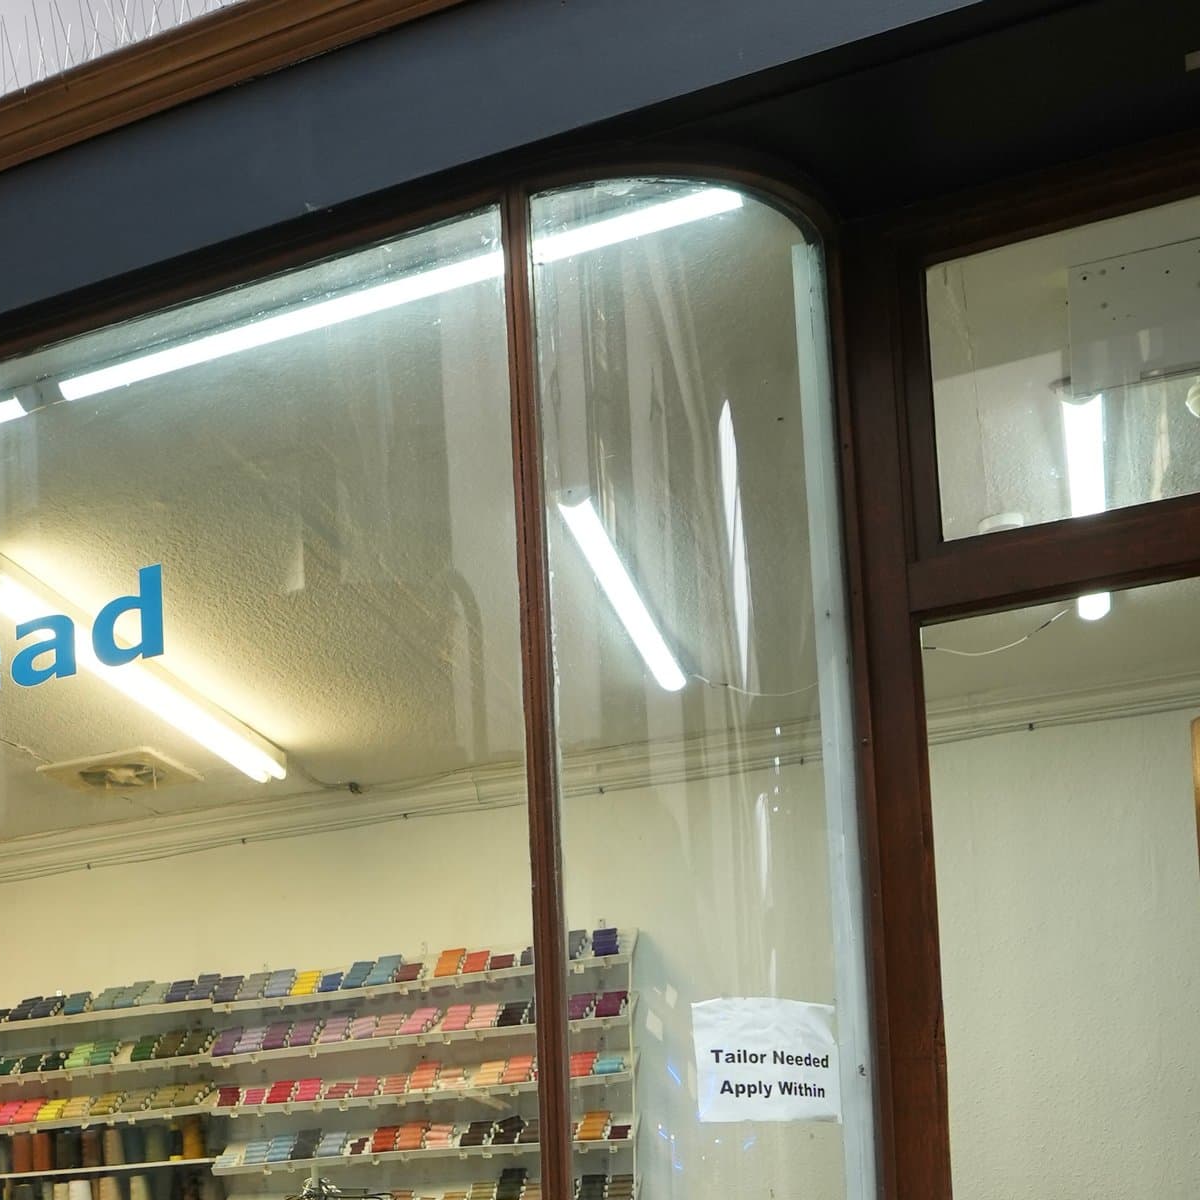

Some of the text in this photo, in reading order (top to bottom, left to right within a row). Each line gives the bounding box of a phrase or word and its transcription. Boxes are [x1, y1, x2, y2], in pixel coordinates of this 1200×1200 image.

[710, 1049, 829, 1069] Tailor Needed
[720, 1080, 825, 1099] Apply Within
